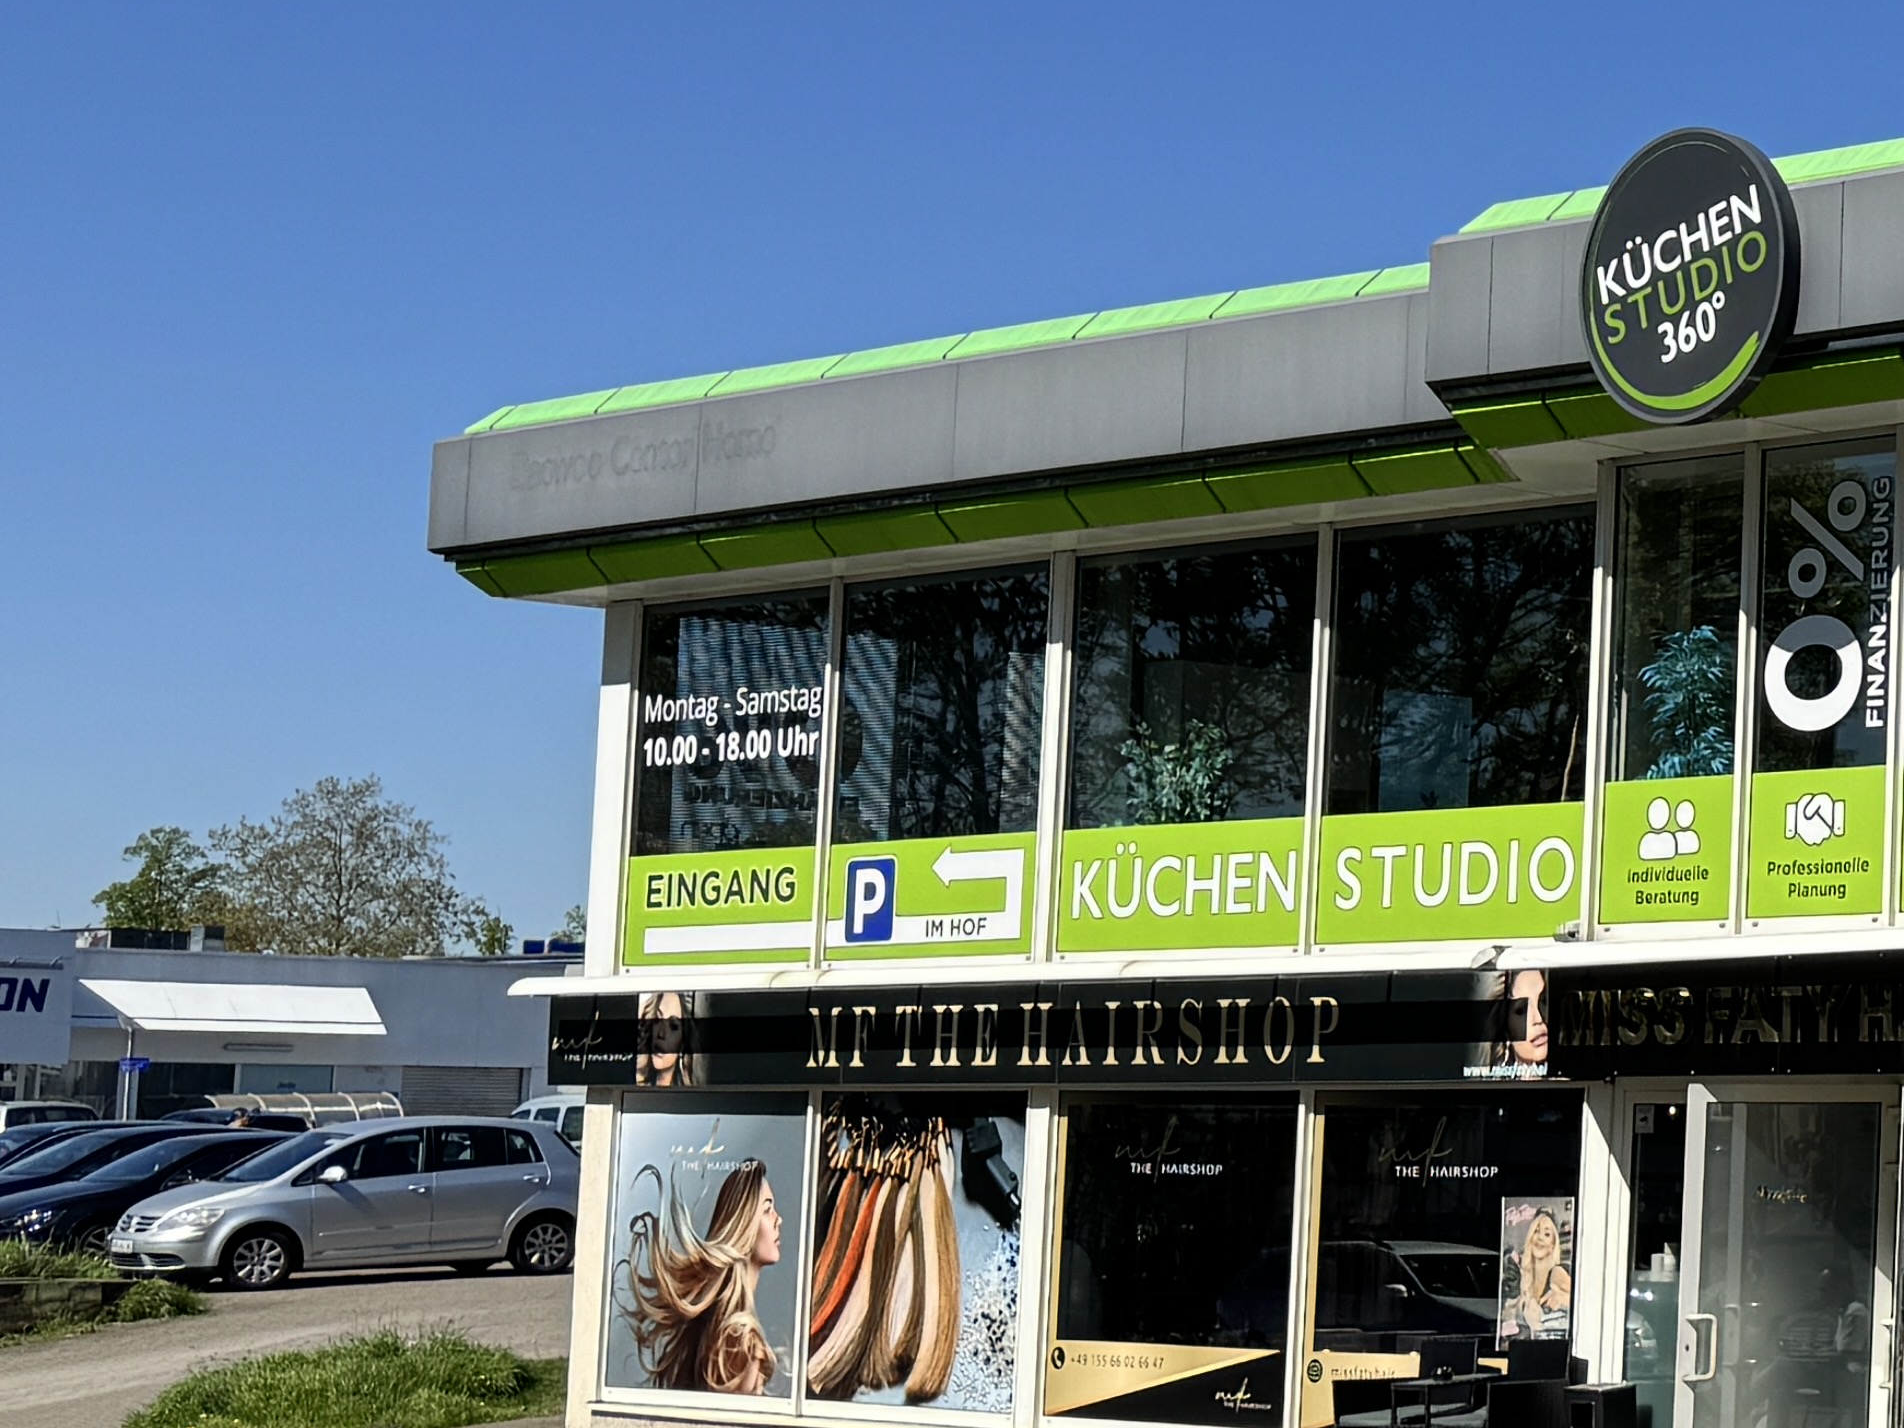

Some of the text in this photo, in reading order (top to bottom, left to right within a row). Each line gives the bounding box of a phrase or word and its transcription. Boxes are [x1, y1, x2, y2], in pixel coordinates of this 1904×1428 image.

[1597, 184, 1762, 304] KÜCHEN
[1604, 231, 1767, 344] STUDIO
[1657, 291, 1726, 364] 360°
[1764, 479, 1867, 732] 0%
[1865, 475, 1893, 729] FINANZIERUNG
[644, 694, 719, 726] Montag
[736, 685, 823, 718] Samstag
[643, 737, 698, 767] 10.00
[717, 732, 772, 762] 18.00
[777, 726, 819, 757] Uhr
[645, 866, 797, 910] EINGANG
[1072, 836, 1576, 920] KÜCHEN STUDIO
[1627, 863, 1710, 885] Individuelle
[1767, 856, 1870, 877] Professionelle
[853, 867, 887, 935] P
[1634, 885, 1700, 908] Beratung
[1787, 880, 1847, 901] Planung
[924, 917, 988, 938] IM HOF
[806, 996, 1340, 1068] MF THE HAIRSHOP
[1558, 986, 1694, 1047] MISS
[1704, 983, 1851, 1044] FATY
[1130, 1162, 1223, 1176] THE HAIRSHOP
[1395, 1165, 1499, 1178] THE HAIRSHOP
